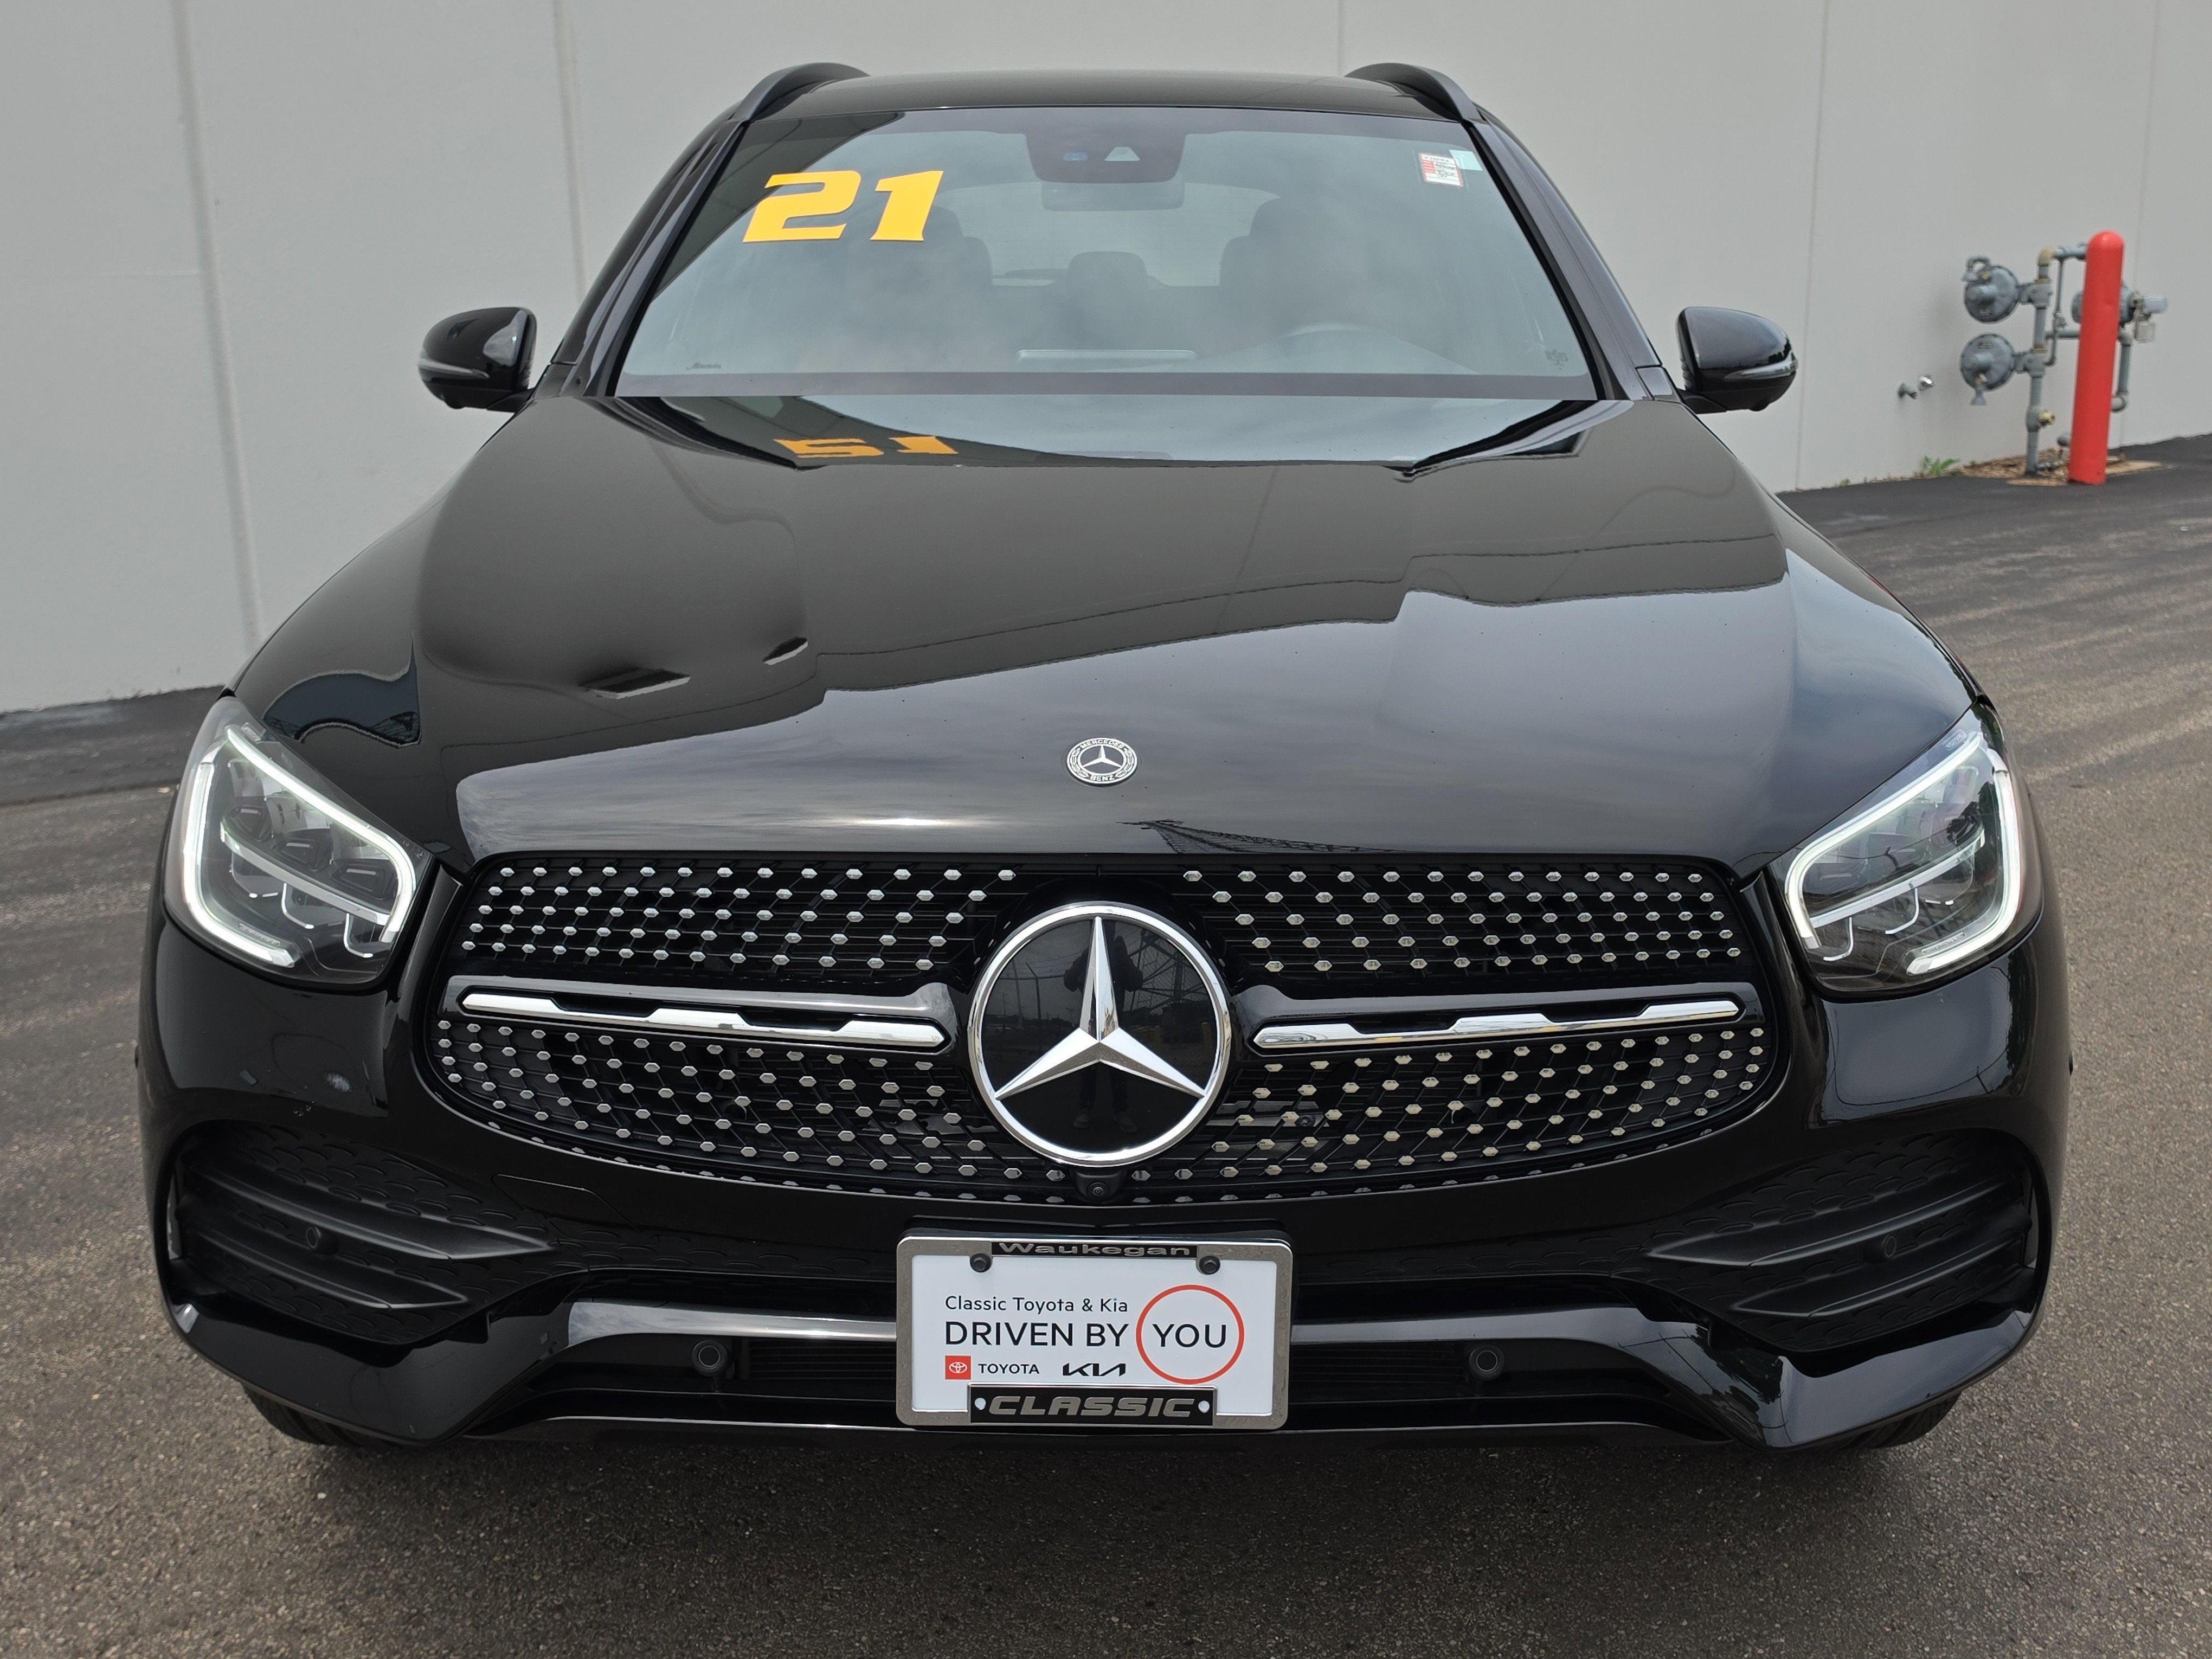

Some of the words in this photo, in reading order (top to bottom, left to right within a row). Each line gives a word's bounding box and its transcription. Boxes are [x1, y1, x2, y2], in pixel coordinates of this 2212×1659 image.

[742, 170, 944, 242] 21
[1080, 739, 1125, 749] MERCEDES
[999, 1243, 1190, 1257] Waukegan
[945, 1295, 1007, 1311] Classic
[1012, 1297, 1074, 1315] Toyota
[1082, 1298, 1093, 1312] &
[1100, 1298, 1128, 1313] Kia
[946, 1321, 1073, 1346] DRIVEN
[1086, 1323, 1129, 1347] BY
[1152, 1323, 1226, 1348] YOU
[978, 1364, 1040, 1374] TOYOTA
[1062, 1362, 1126, 1377] KIA
[988, 1396, 1195, 1417] CLASSIC
